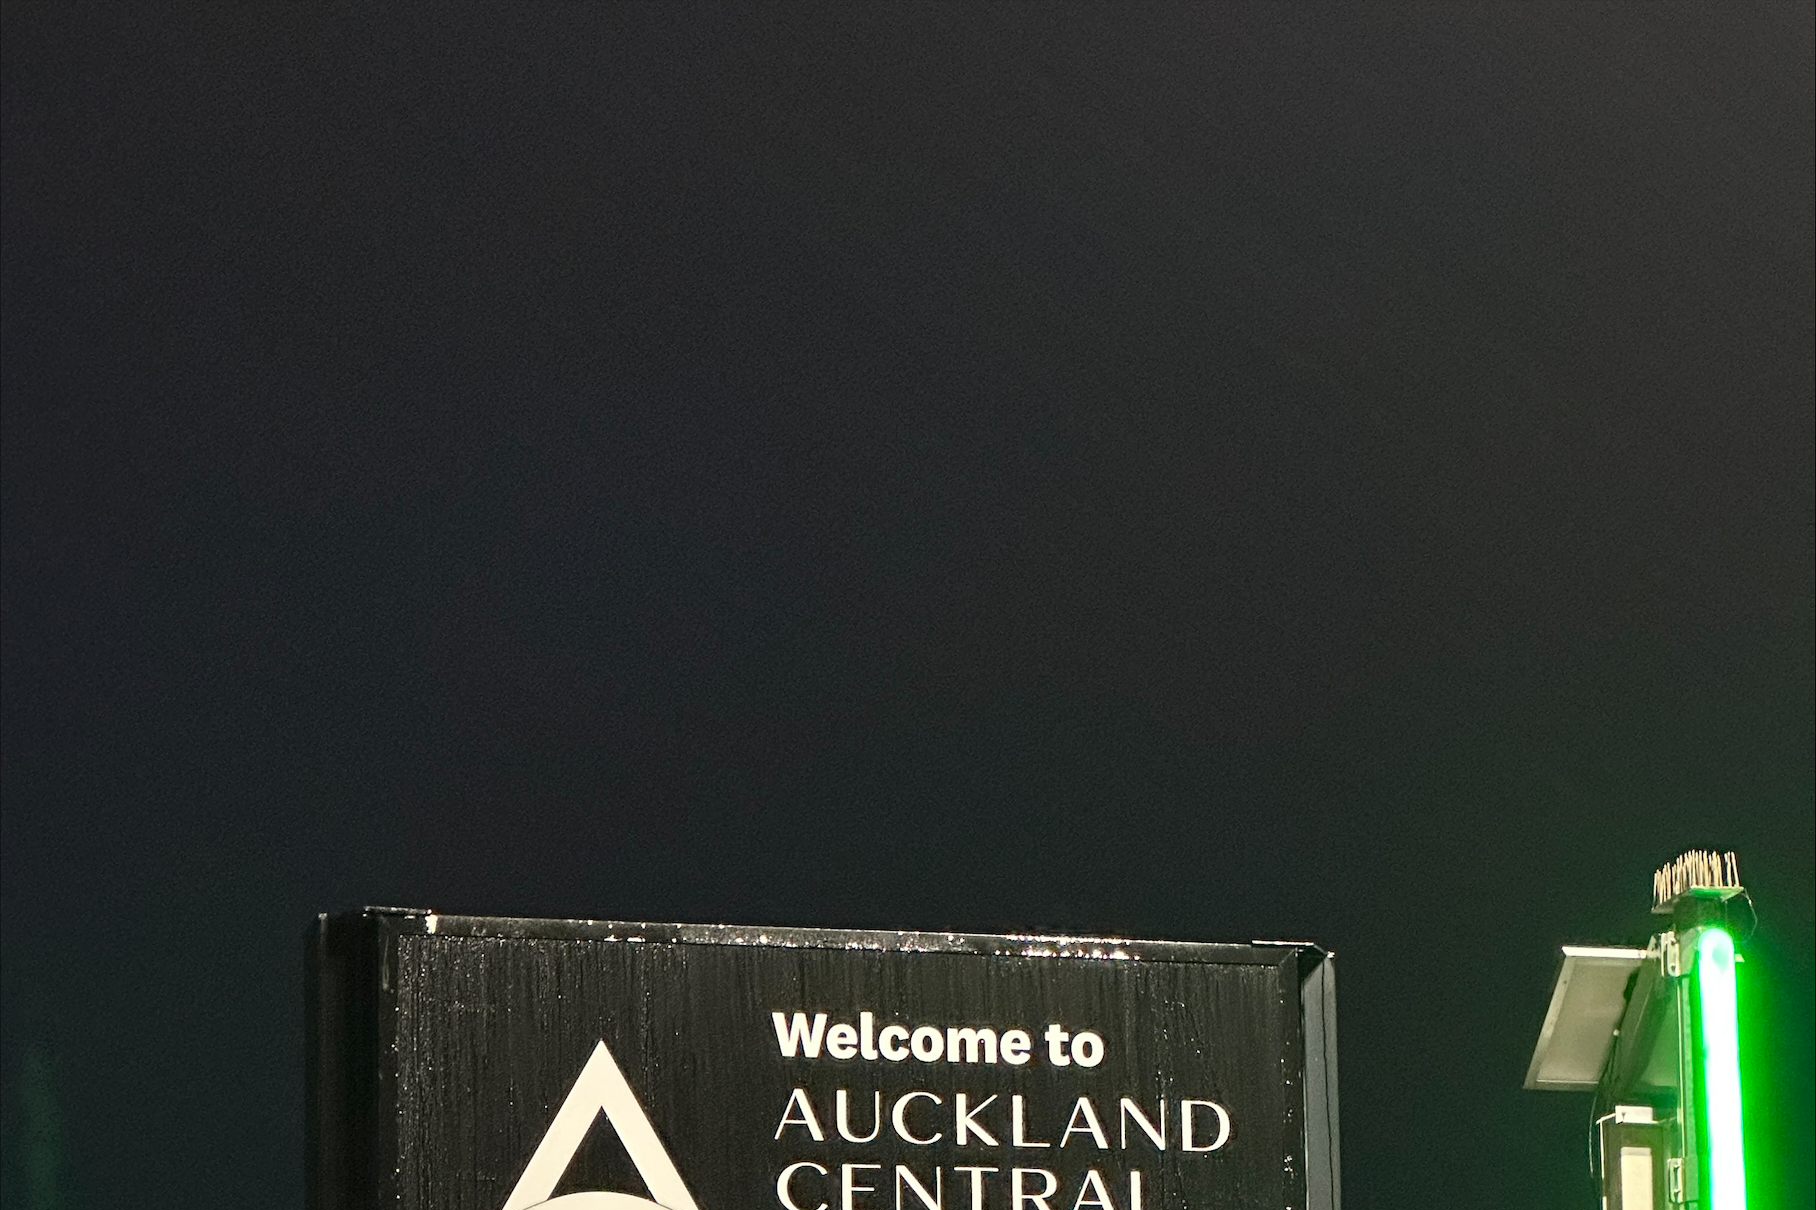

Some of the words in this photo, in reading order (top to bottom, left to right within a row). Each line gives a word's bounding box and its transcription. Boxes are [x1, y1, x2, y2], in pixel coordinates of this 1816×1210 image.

[771, 1010, 1032, 1066] Welcome
[1044, 1022, 1106, 1068] to
[774, 1087, 1231, 1153] AUCKLAND
